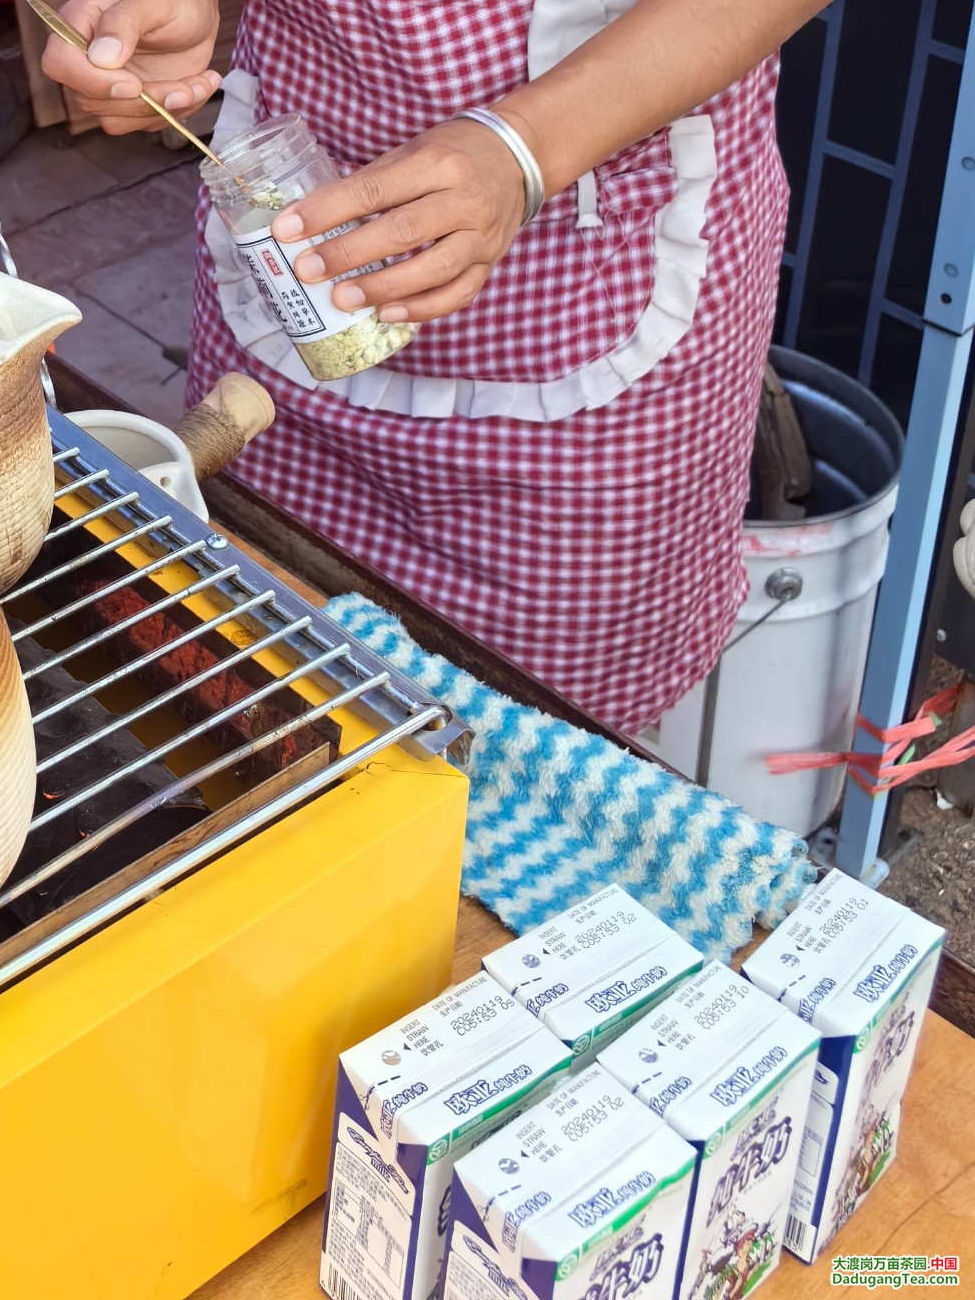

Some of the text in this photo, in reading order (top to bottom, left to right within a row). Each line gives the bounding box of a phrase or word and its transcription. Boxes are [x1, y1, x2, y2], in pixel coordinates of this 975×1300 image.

[804, 900, 816, 910] DATE
[814, 898, 831, 914] 生产日期
[856, 898, 868, 909] 01
[567, 908, 581, 918] DATE
[575, 910, 596, 924] 生产日期
[622, 912, 636, 924] 02
[819, 897, 856, 934] 20240119
[538, 926, 557, 939] INSERT
[574, 911, 624, 943] 20240119
[786, 921, 801, 936] INSERT
[794, 925, 811, 942] STRAW
[544, 931, 565, 946] STRAW
[803, 936, 816, 948] HERE
[552, 942, 566, 953] HERE
[431, 999, 446, 1010] DATE
[453, 976, 487, 997] MANUFACTURE
[675, 991, 689, 1002] DATE
[735, 985, 748, 998] 10
[500, 998, 514, 1009] 09
[684, 991, 704, 1008] 生产日期
[694, 984, 738, 1023] 20240119
[439, 1000, 462, 1017] 生产日期
[450, 995, 502, 1029] 20240119
[400, 1019, 420, 1034] INSERT
[650, 1014, 668, 1030] INSERT
[657, 1020, 678, 1037] STRAW
[406, 1024, 428, 1041] STRAW
[666, 1030, 680, 1043] HERE
[413, 1036, 429, 1048] HERE
[546, 1097, 561, 1109] DATE
[555, 1098, 578, 1116] 生产日期
[609, 1096, 624, 1110] 02
[561, 1095, 610, 1135] 20240119
[515, 1120, 535, 1139] INSERT
[522, 1127, 545, 1147] STRAW
[530, 1140, 546, 1154] HERE
[706, 1116, 792, 1228] 纯牛奶
[578, 1232, 664, 1300] 牛奶
